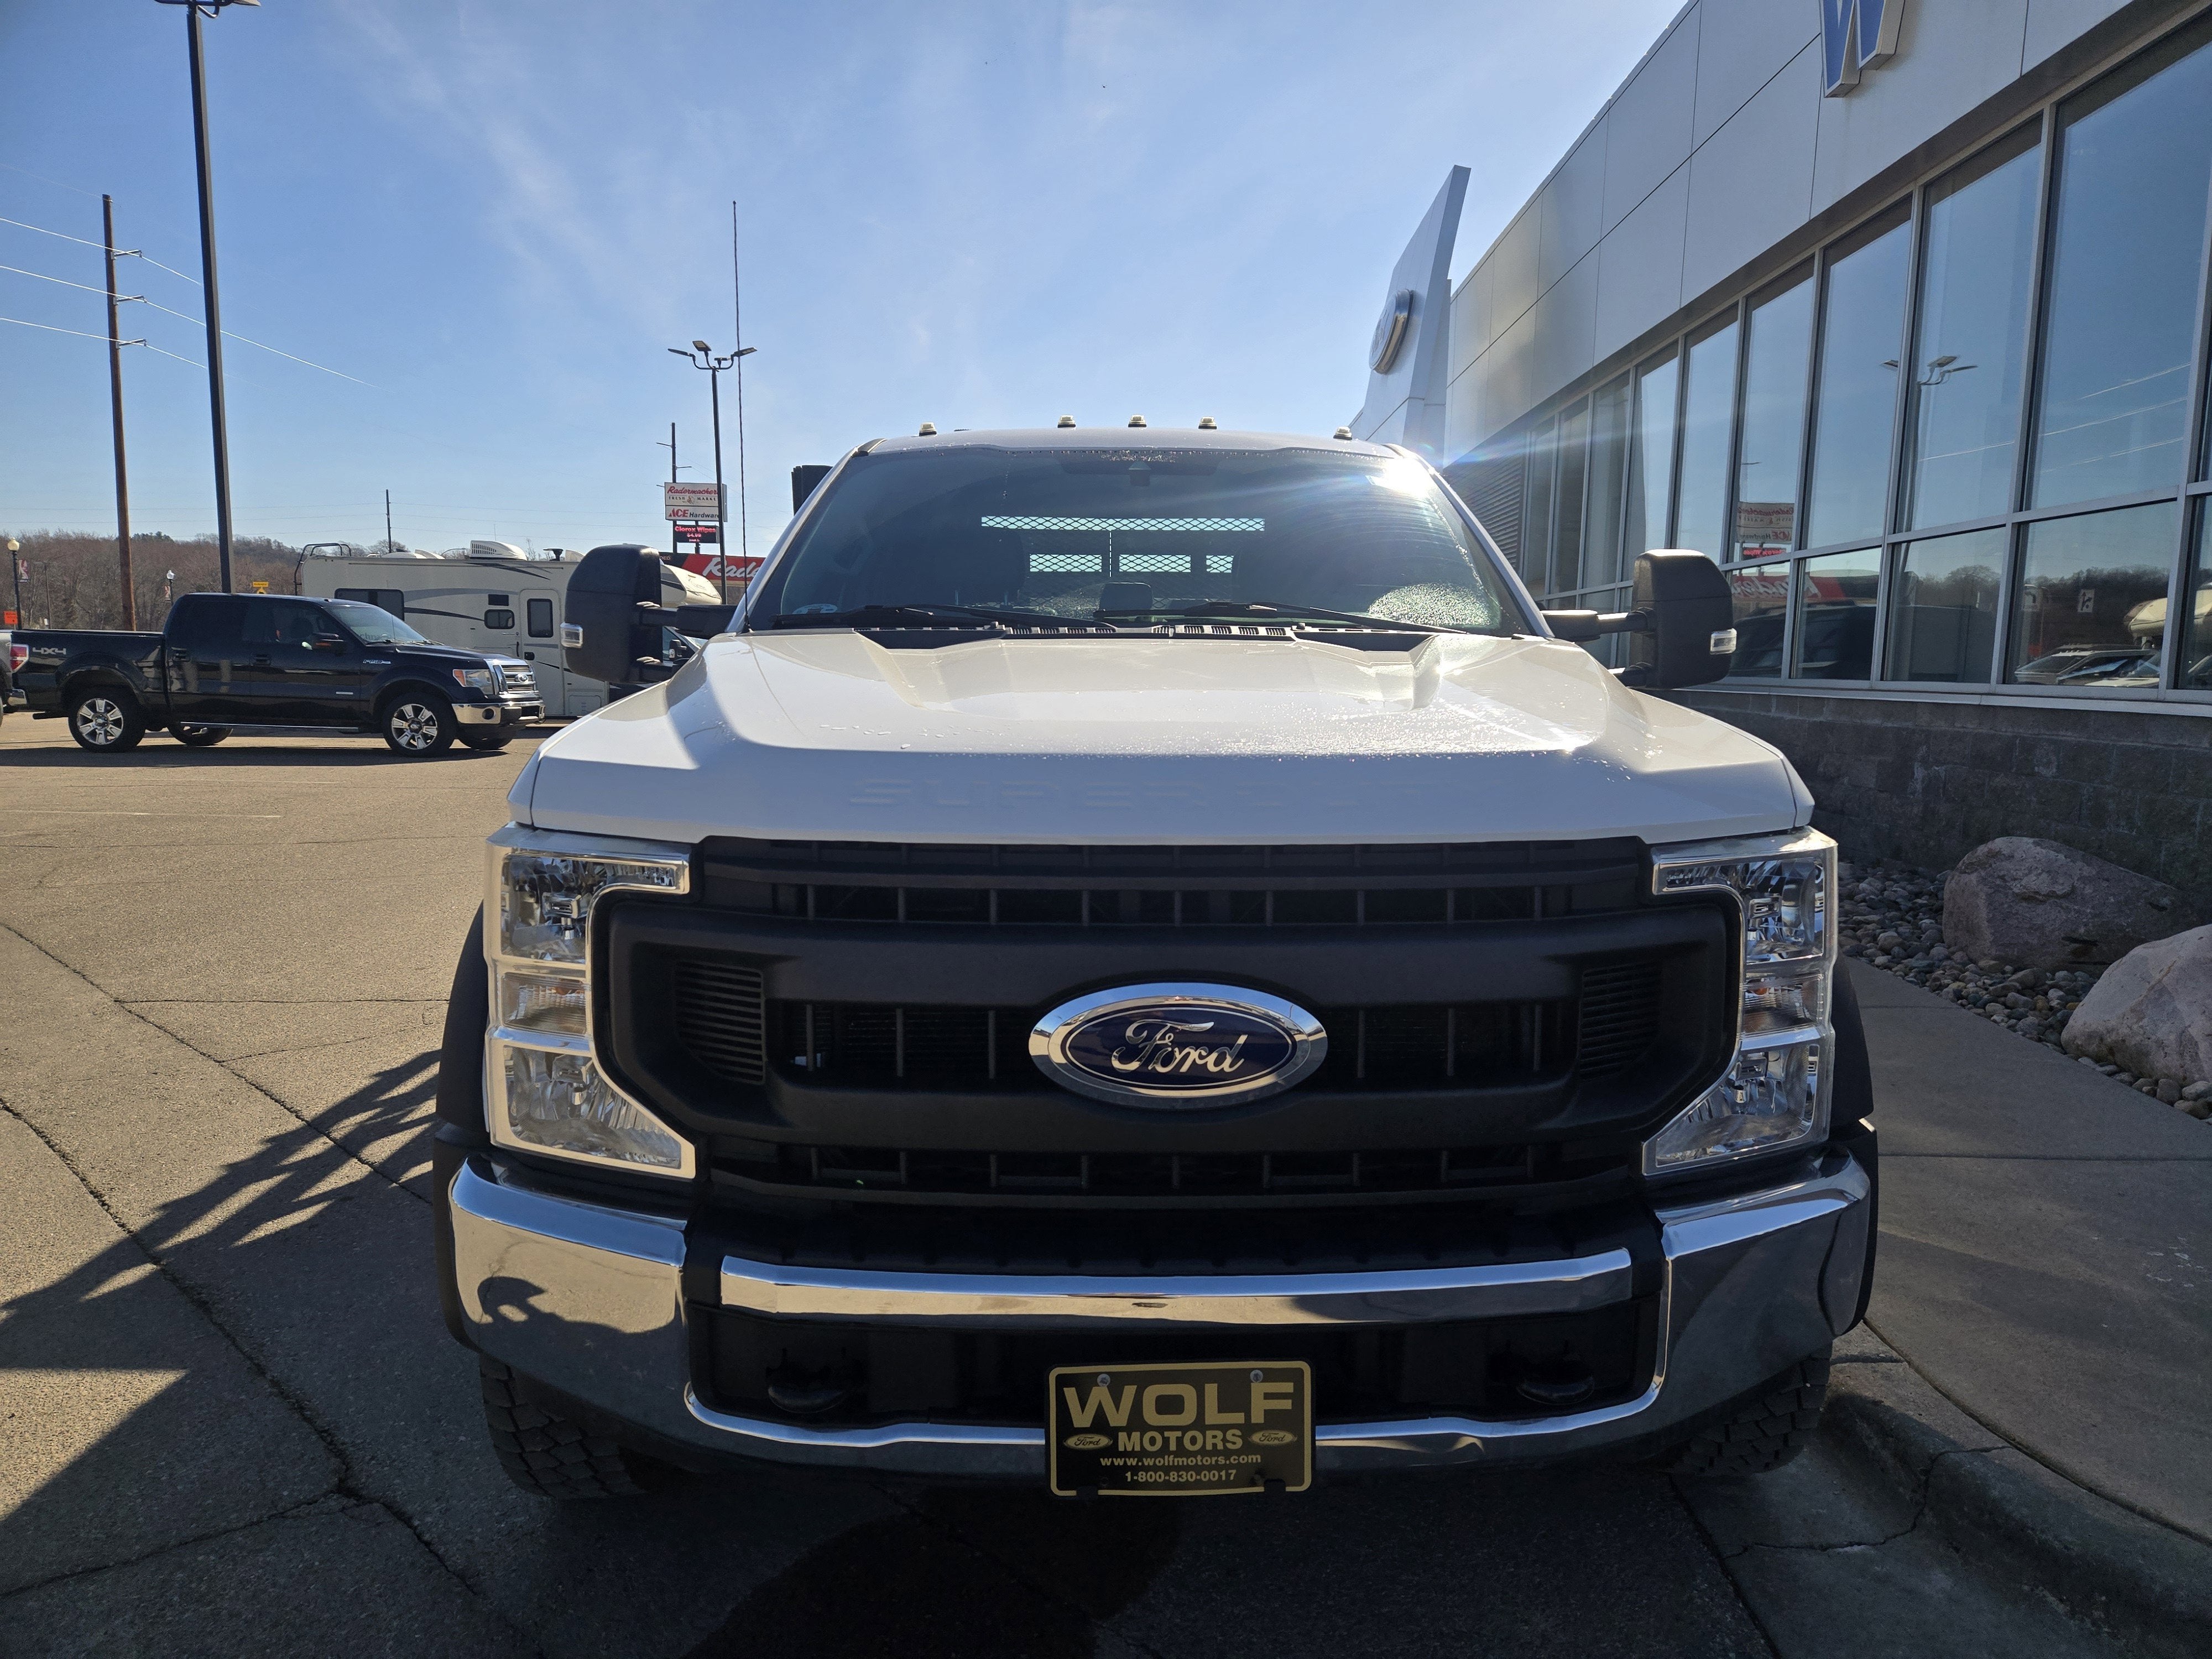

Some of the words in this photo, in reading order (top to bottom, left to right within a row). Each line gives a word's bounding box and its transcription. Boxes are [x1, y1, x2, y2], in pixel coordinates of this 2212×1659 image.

[667, 486, 718, 495] Radermacher
[668, 508, 689, 518] ACE
[1110, 1019, 1248, 1073] Ford
[1063, 1382, 1294, 1428] WOLF
[1074, 1436, 1101, 1447] Ford
[1118, 1429, 1243, 1452] MOTORS
[1258, 1432, 1286, 1443] Ford
[1100, 1453, 1262, 1467] www.wolfmotors.com
[1125, 1469, 1237, 1483] 1-800-830-0017
